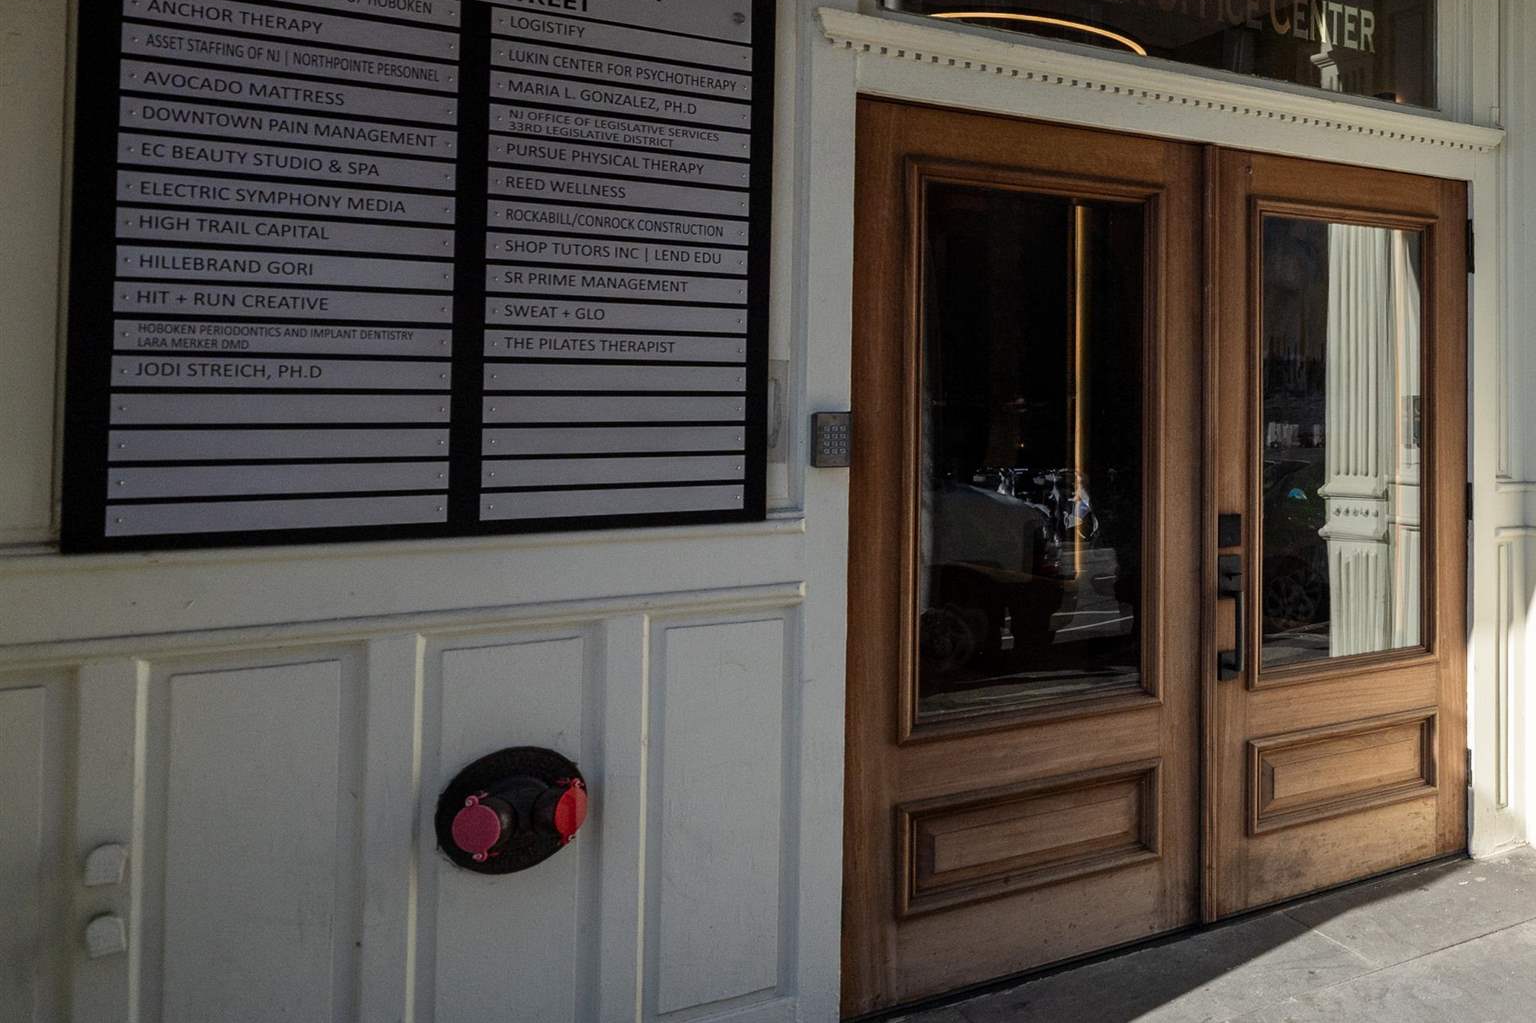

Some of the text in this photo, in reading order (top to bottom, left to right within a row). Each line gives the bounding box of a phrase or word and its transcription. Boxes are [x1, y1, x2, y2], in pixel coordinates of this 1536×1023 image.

[238, 10, 322, 34] THERAPY
[509, 15, 585, 38] LOGISTIFY
[145, 33, 184, 50] ASSET
[186, 37, 244, 58] STAFFING
[246, 45, 263, 59] OF
[265, 48, 280, 62] NJ
[292, 51, 374, 74] NORTHPOINTE
[376, 61, 439, 82] PERSONNEL
[507, 48, 736, 91] LUKIN CENTER FOR PSYCHOTHERAPY
[143, 70, 344, 106] AVOCADO MATTRESS
[507, 79, 697, 115] MARIA L. GONZALEZ, PH.D
[141, 104, 437, 147] DOWNTOWN PAIN MANAGEMENT
[508, 108, 719, 141] NJ OFFICE OF LEGISLATIVE SERVICES
[508, 120, 673, 147] 33RD LEGISLATIVE DISTRICT
[140, 141, 379, 176] EC BEAUTY STUDIO & SPA
[505, 142, 704, 175] PURSUE PHYSICAL THERAPY
[139, 180, 405, 213] ELECTRIC SYMPHONY MEDIA
[505, 175, 626, 198] REED WELLNESS
[138, 214, 329, 240] HIGH TRAIL CAPITAL
[505, 207, 723, 237] ROCKABILL/CONROCK CONSTRUCTION
[504, 238, 548, 254] SHOP
[551, 241, 610, 258] TUTORS
[614, 246, 639, 259] INC
[654, 248, 690, 262] LEND
[693, 251, 721, 264] EDU
[138, 254, 312, 275] HILLEBRAND GORI
[504, 270, 688, 292] SR PRIME MANAGEMENT
[136, 289, 170, 304] HIT
[193, 291, 235, 307] RUN
[241, 293, 328, 311] CREATIVE
[503, 303, 558, 318] SWEAT
[574, 306, 605, 320] GLO
[137, 322, 413, 340] HOBOKEN PERIODONTICS AND IMPLANT DENTISTRY
[137, 336, 248, 349] LARA MERKER DMD
[503, 335, 675, 353] THE PILATES THERAPIST
[134, 361, 322, 380] JODI STREICH, PH.D
